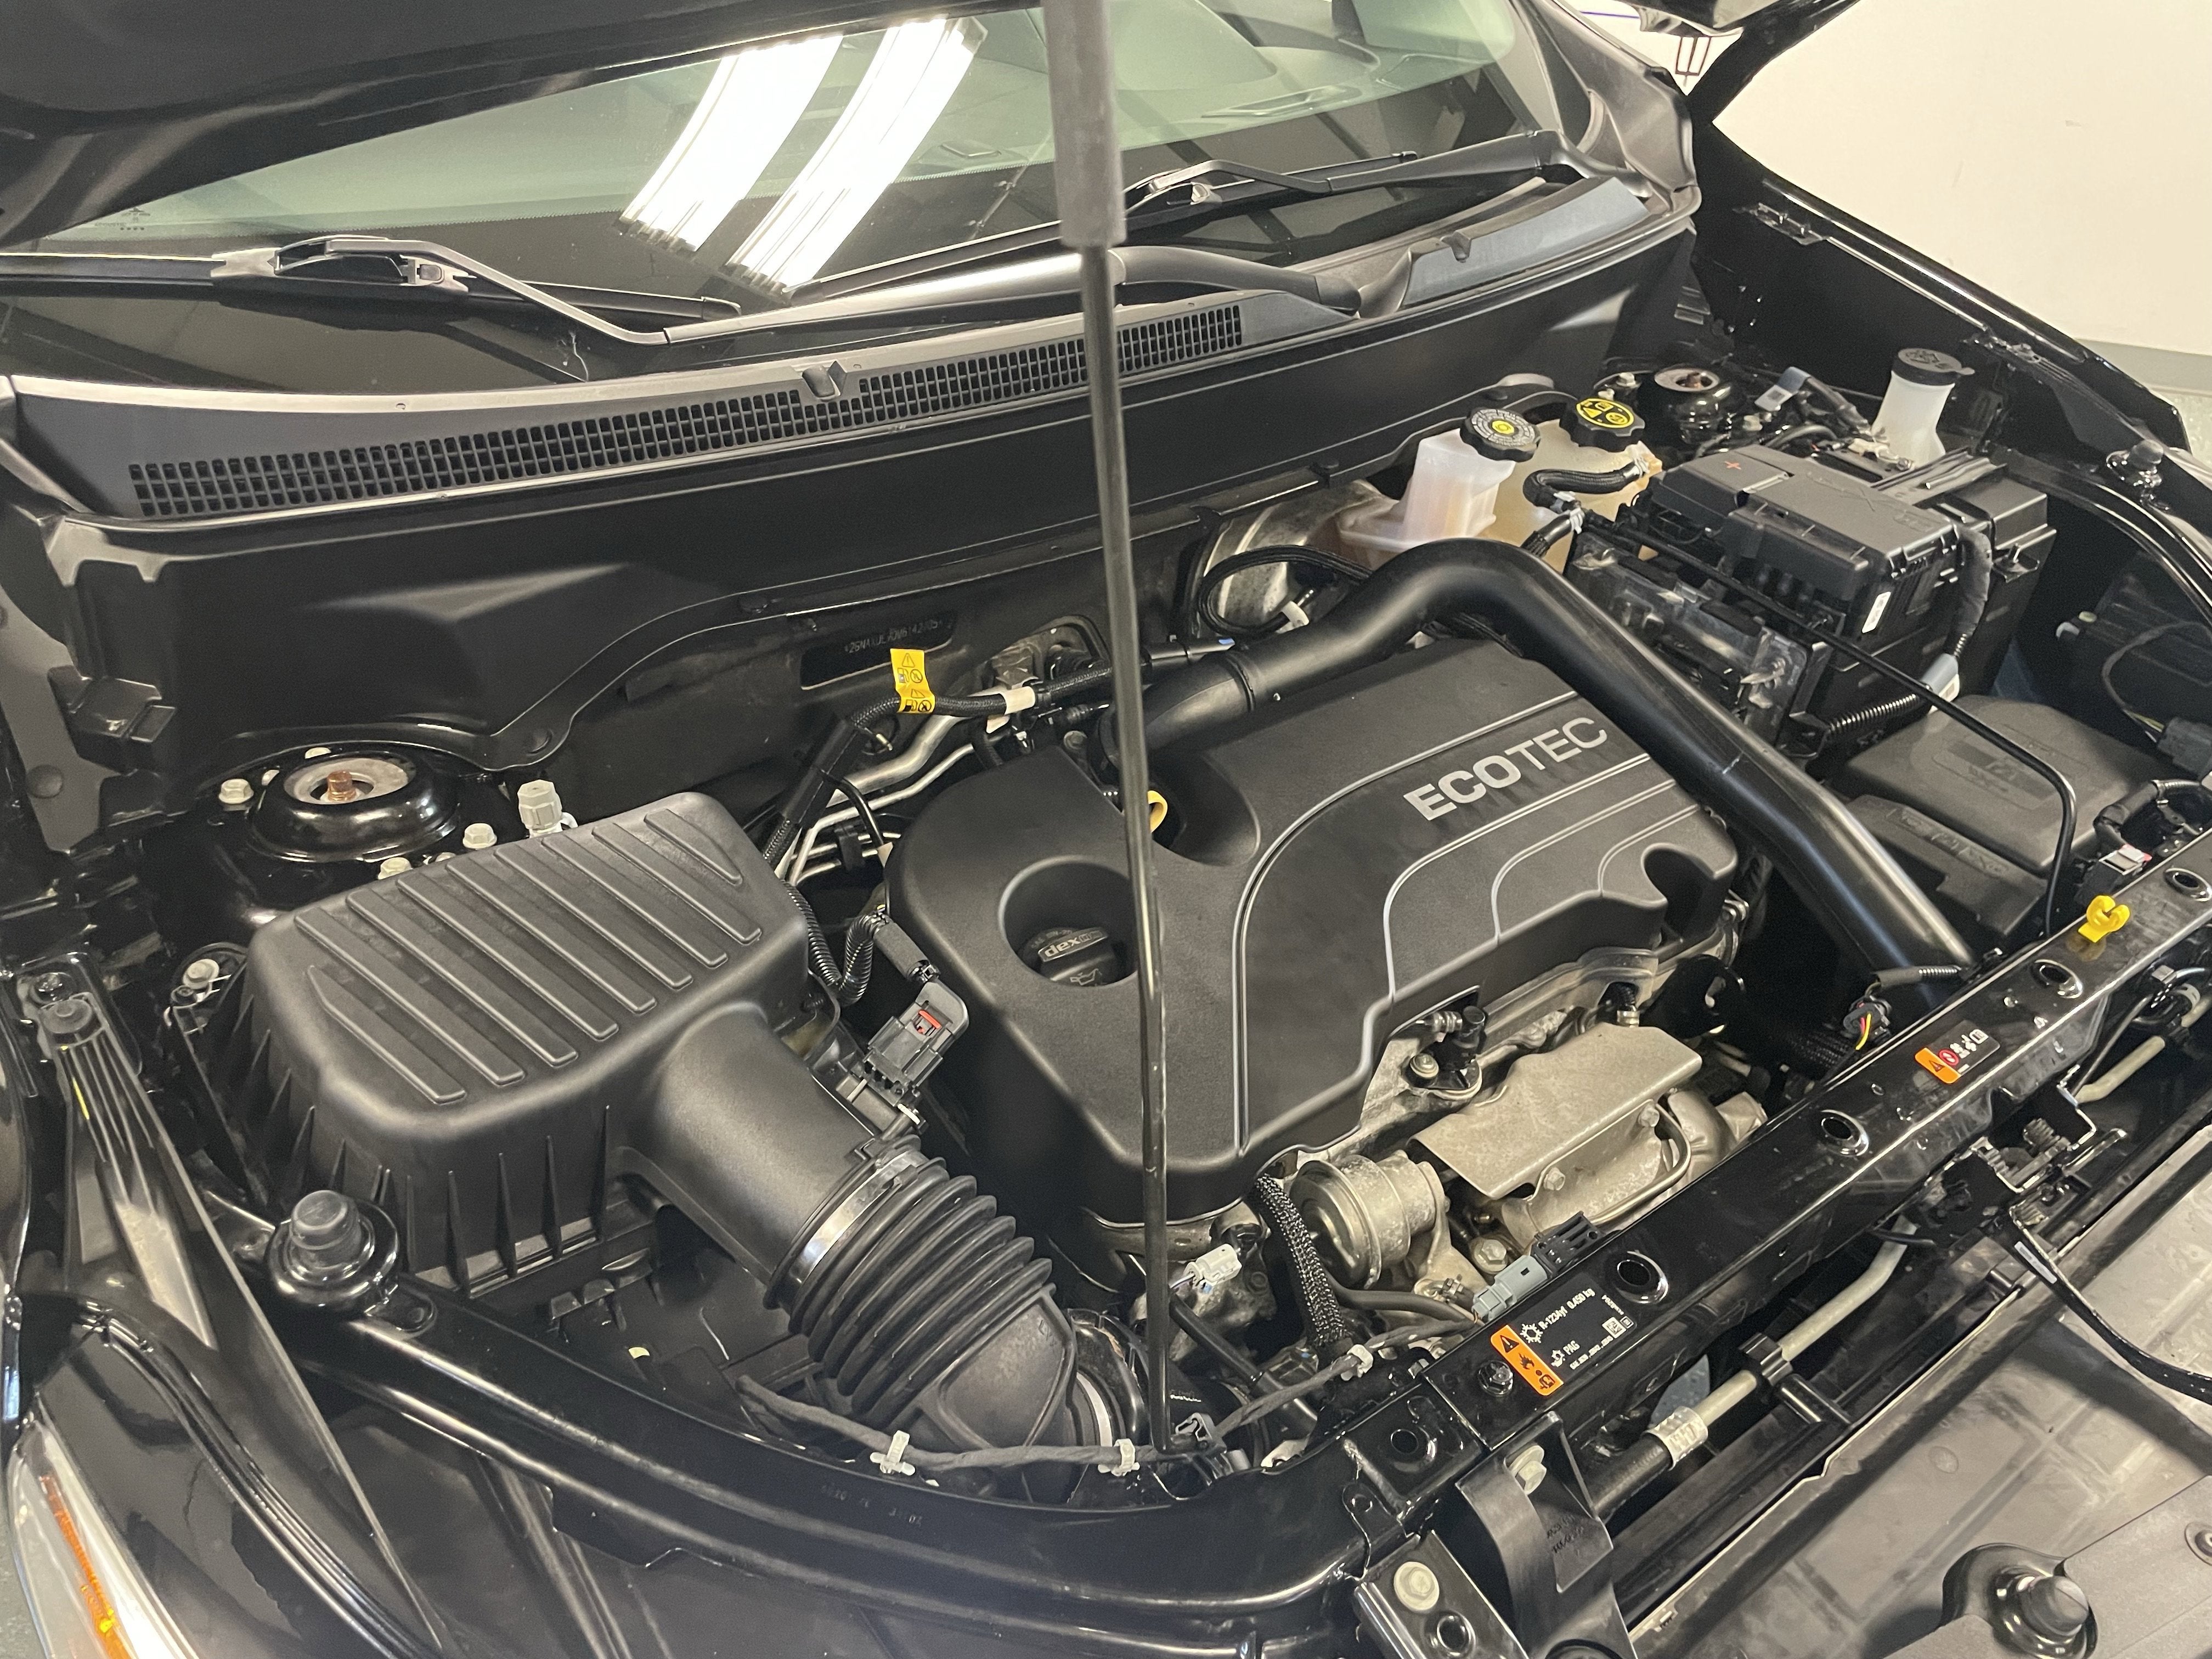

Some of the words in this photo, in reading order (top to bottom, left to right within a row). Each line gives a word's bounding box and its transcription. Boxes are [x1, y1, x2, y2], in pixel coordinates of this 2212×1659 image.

[1403, 716, 1608, 821] ECOTEC
[1538, 1305, 1568, 1330] R-1234yf
[1582, 1288, 1596, 1298] kg
[1562, 1340, 1581, 1355] PAG
